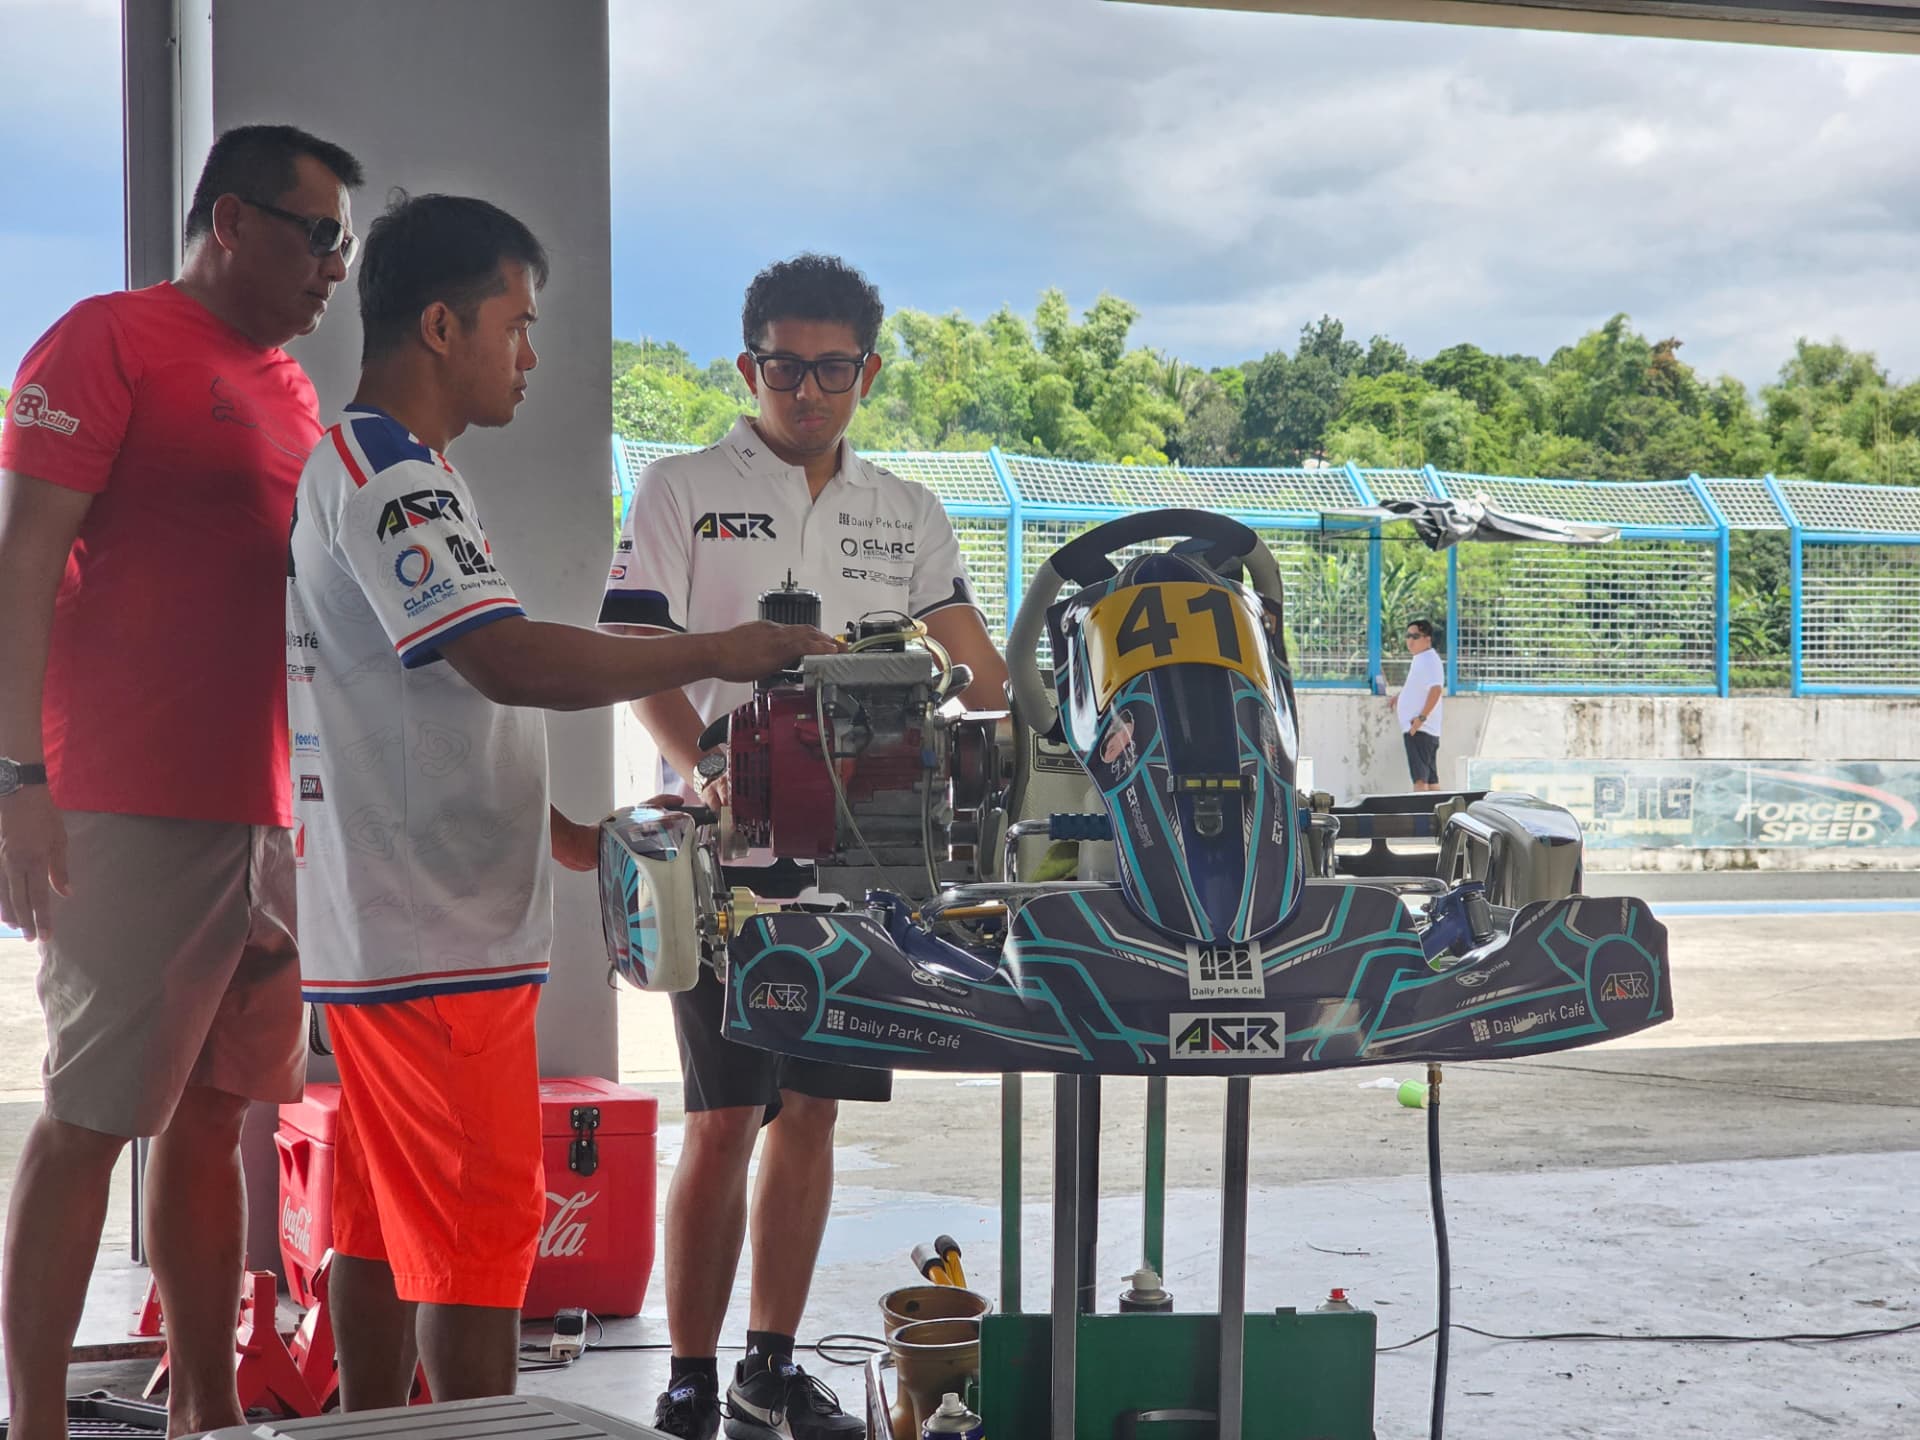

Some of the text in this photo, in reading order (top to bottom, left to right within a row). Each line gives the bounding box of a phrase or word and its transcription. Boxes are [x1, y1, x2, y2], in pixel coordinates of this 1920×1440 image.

[694, 512, 776, 538] AGR
[851, 517, 873, 528] Daily
[876, 517, 892, 528] Prk
[863, 539, 915, 553] CLARC
[403, 578, 454, 611] CLARC
[1116, 586, 1242, 664] 41
[1734, 801, 1882, 822] FORCED
[1759, 822, 1876, 842] SPEED
[1192, 986, 1262, 996] Daily Park Café
[1560, 1000, 1585, 1019] Café
[849, 1016, 884, 1038] Daily
[888, 1023, 923, 1042] Park
[927, 1031, 961, 1049] Café
[1176, 1018, 1279, 1050] AGR
[539, 1191, 600, 1258] la
